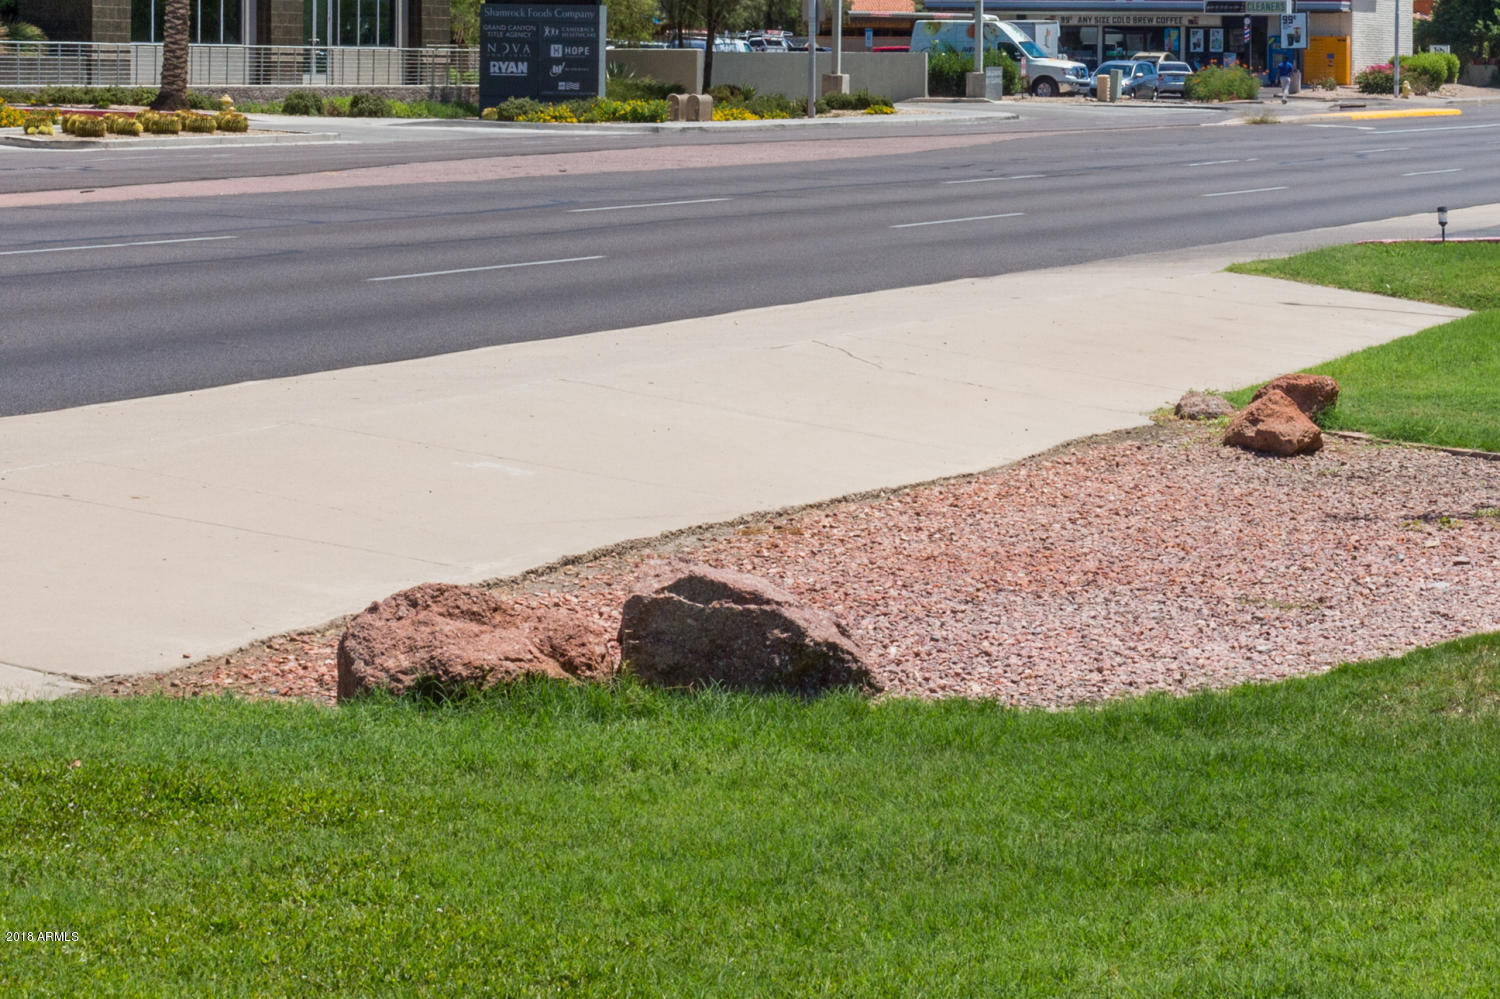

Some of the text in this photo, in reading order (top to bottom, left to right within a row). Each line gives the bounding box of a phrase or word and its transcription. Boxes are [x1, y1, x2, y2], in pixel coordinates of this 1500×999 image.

[484, 8, 593, 19] Shamrock Foods Company
[1077, 16, 1092, 24] ANY
[1095, 16, 1110, 24] SIZE
[1112, 16, 1131, 24] COLD
[1133, 16, 1154, 24] BREW
[1156, 16, 1183, 25] COFFEE
[565, 46, 590, 55] HOPE
[490, 61, 528, 73] RYAN
